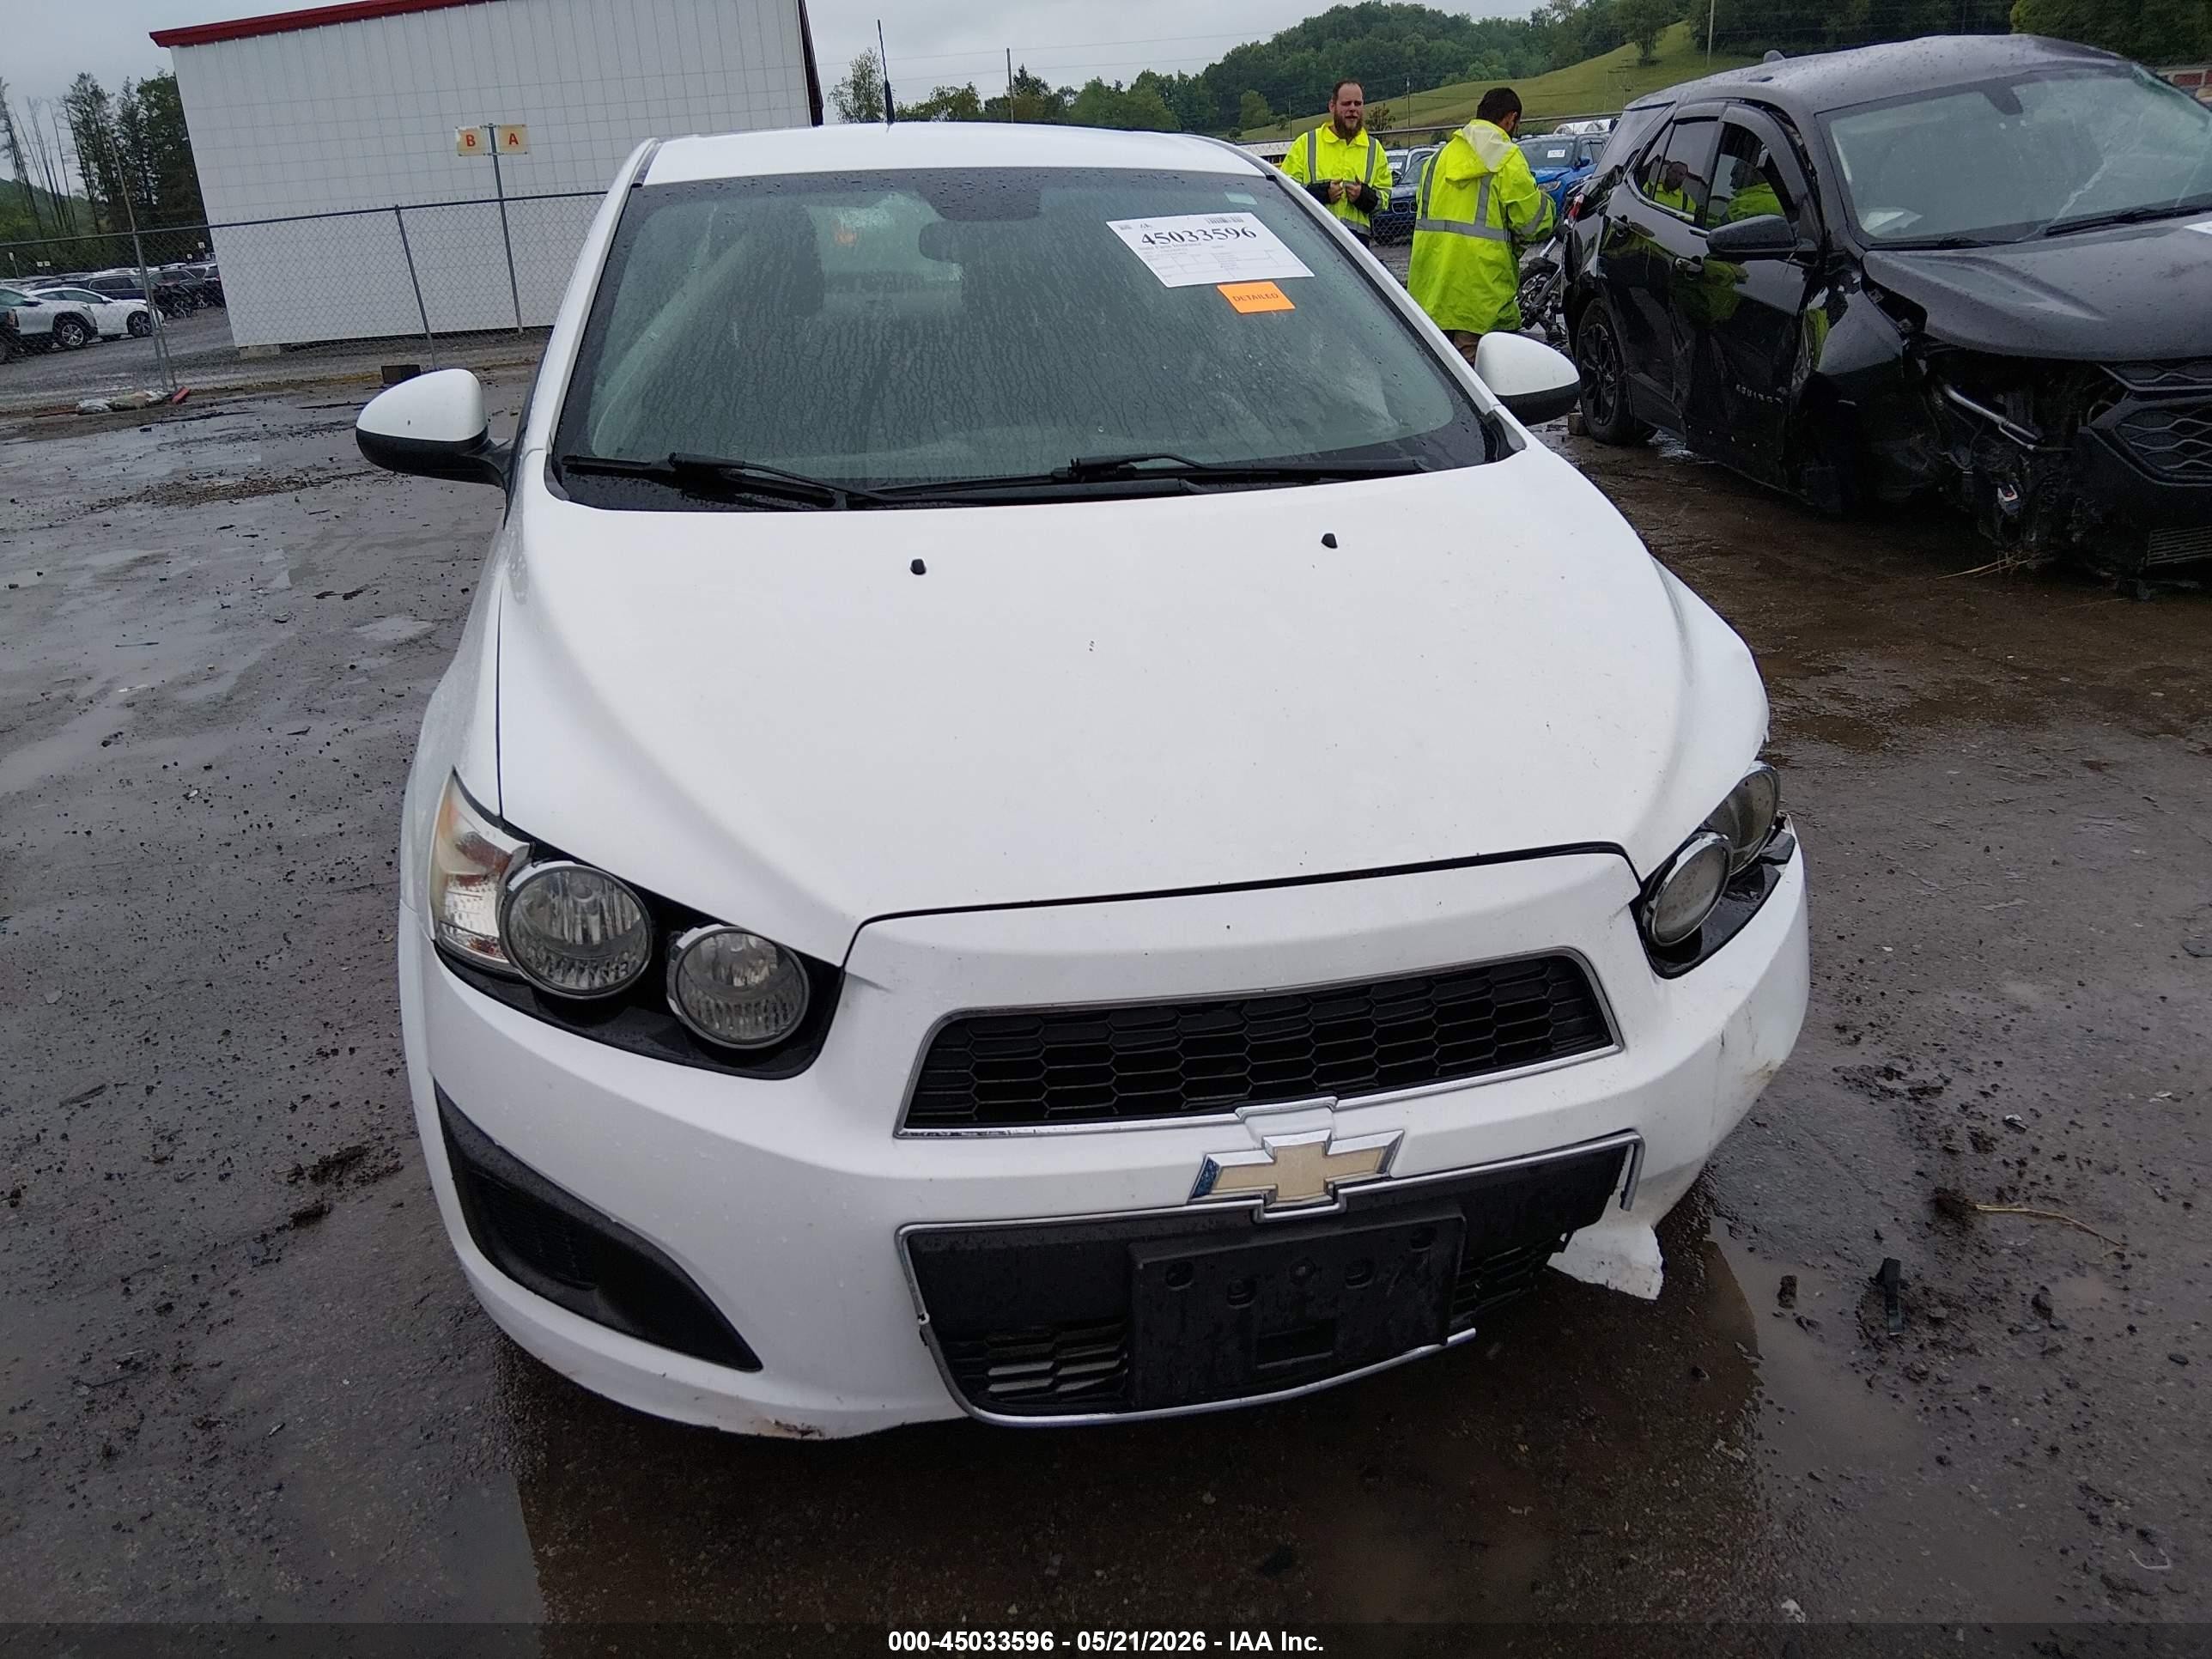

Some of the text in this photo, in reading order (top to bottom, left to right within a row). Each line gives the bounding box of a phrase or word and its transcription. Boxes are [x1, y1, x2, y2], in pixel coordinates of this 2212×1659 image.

[466, 135, 476, 147] B
[508, 133, 519, 145] A
[1141, 226, 1257, 246] 45033596
[1231, 293, 1279, 301] DETAILED
